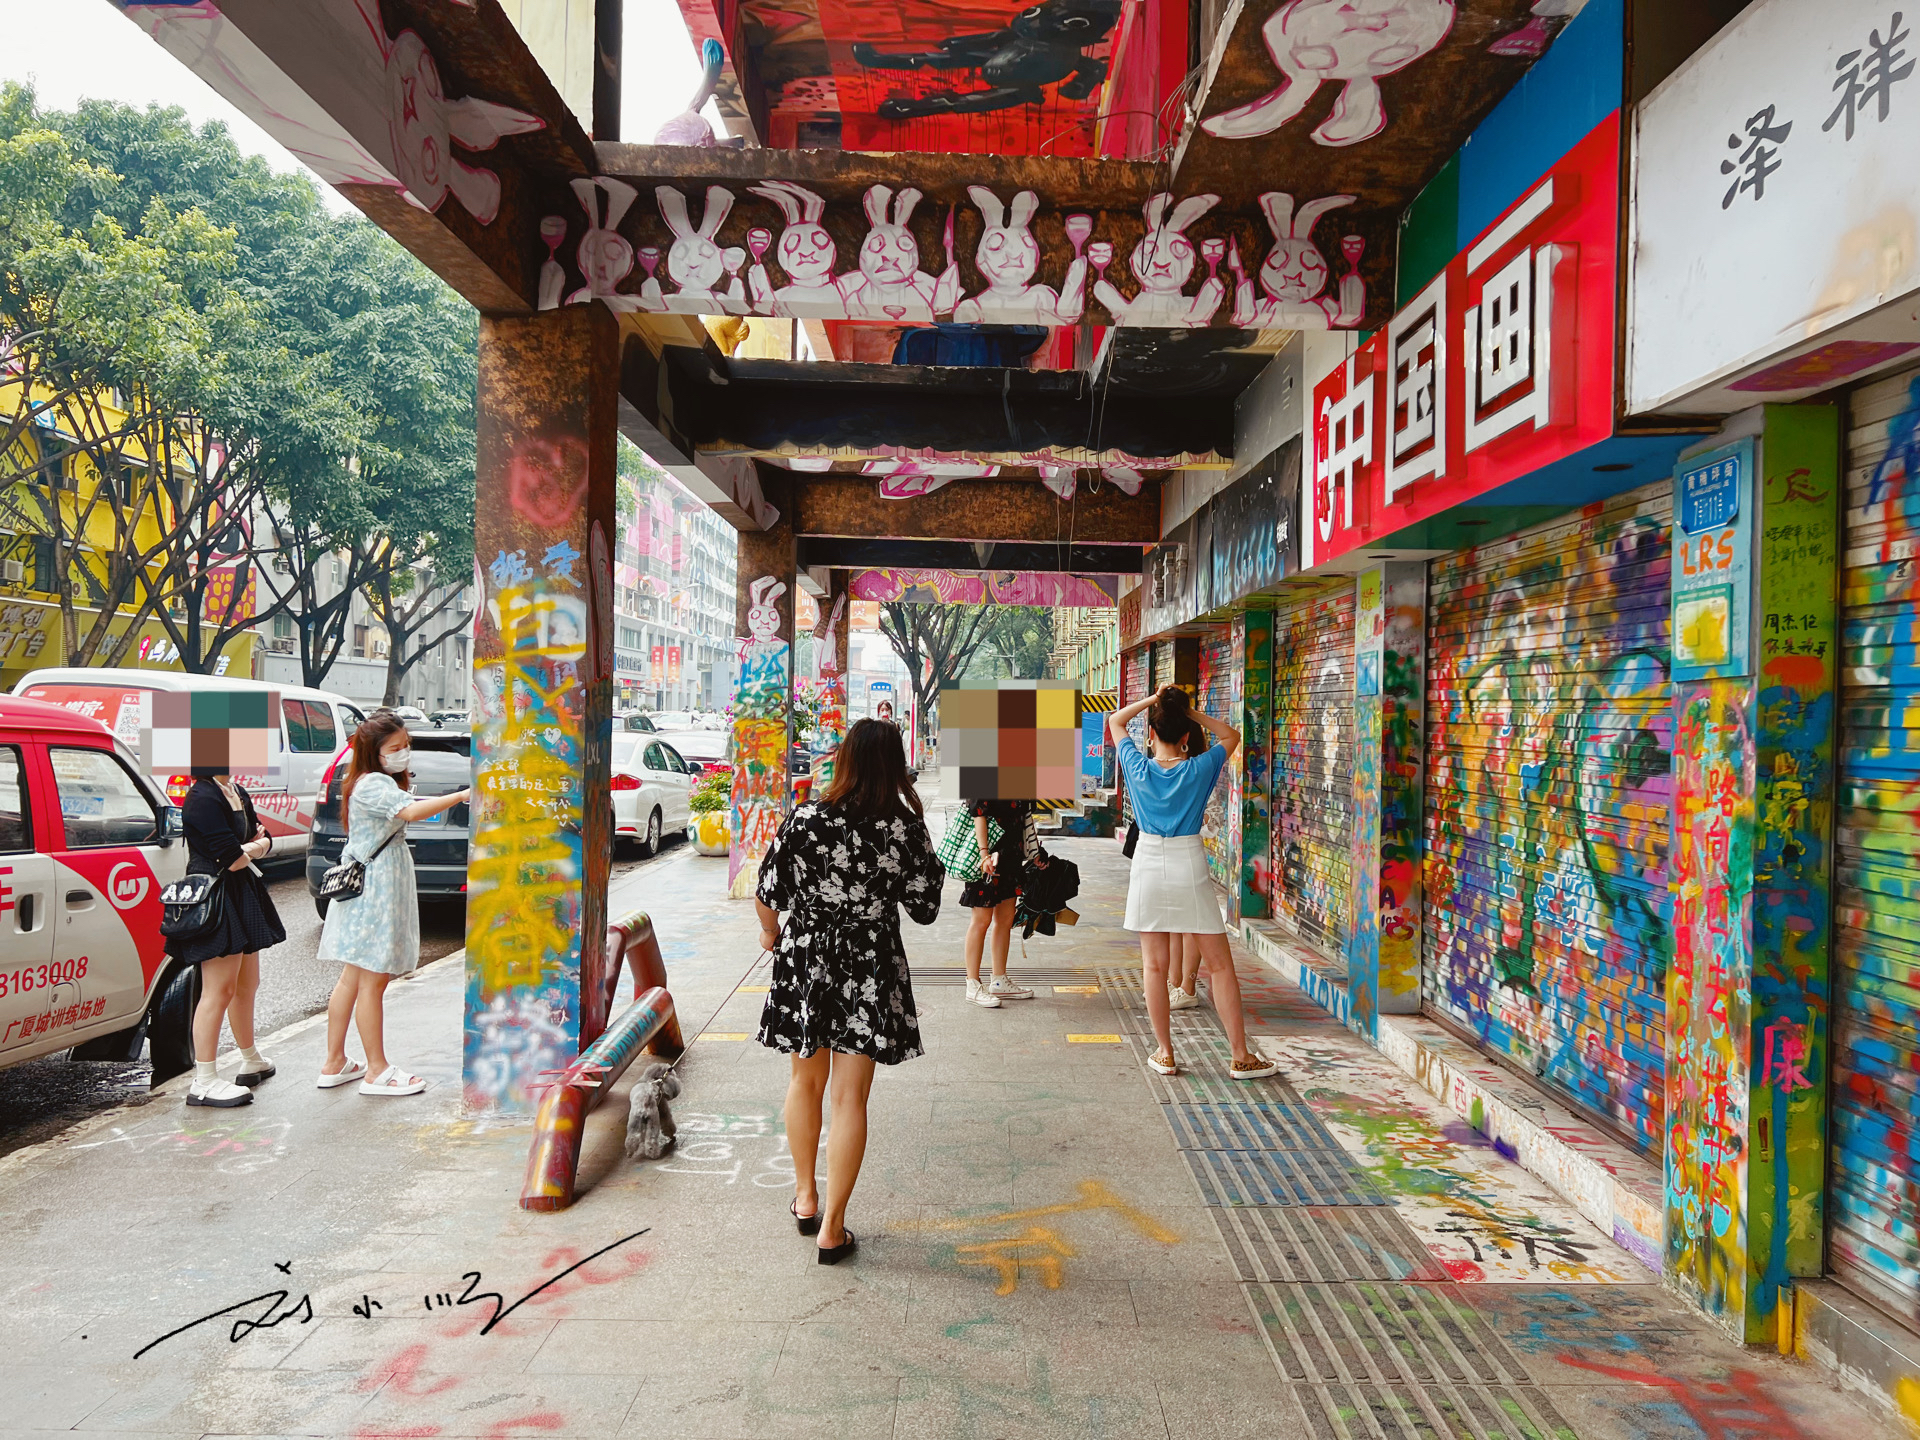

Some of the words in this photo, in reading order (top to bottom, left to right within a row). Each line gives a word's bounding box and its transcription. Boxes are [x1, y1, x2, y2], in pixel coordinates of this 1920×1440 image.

[1720, 11, 1917, 210] 泽祥
[1328, 175, 1559, 530] 中国画
[1764, 613, 1818, 634] 周杰伦
[526, 796, 571, 813] 天天开心
[3, 995, 107, 1044] 广厦城训练场地
